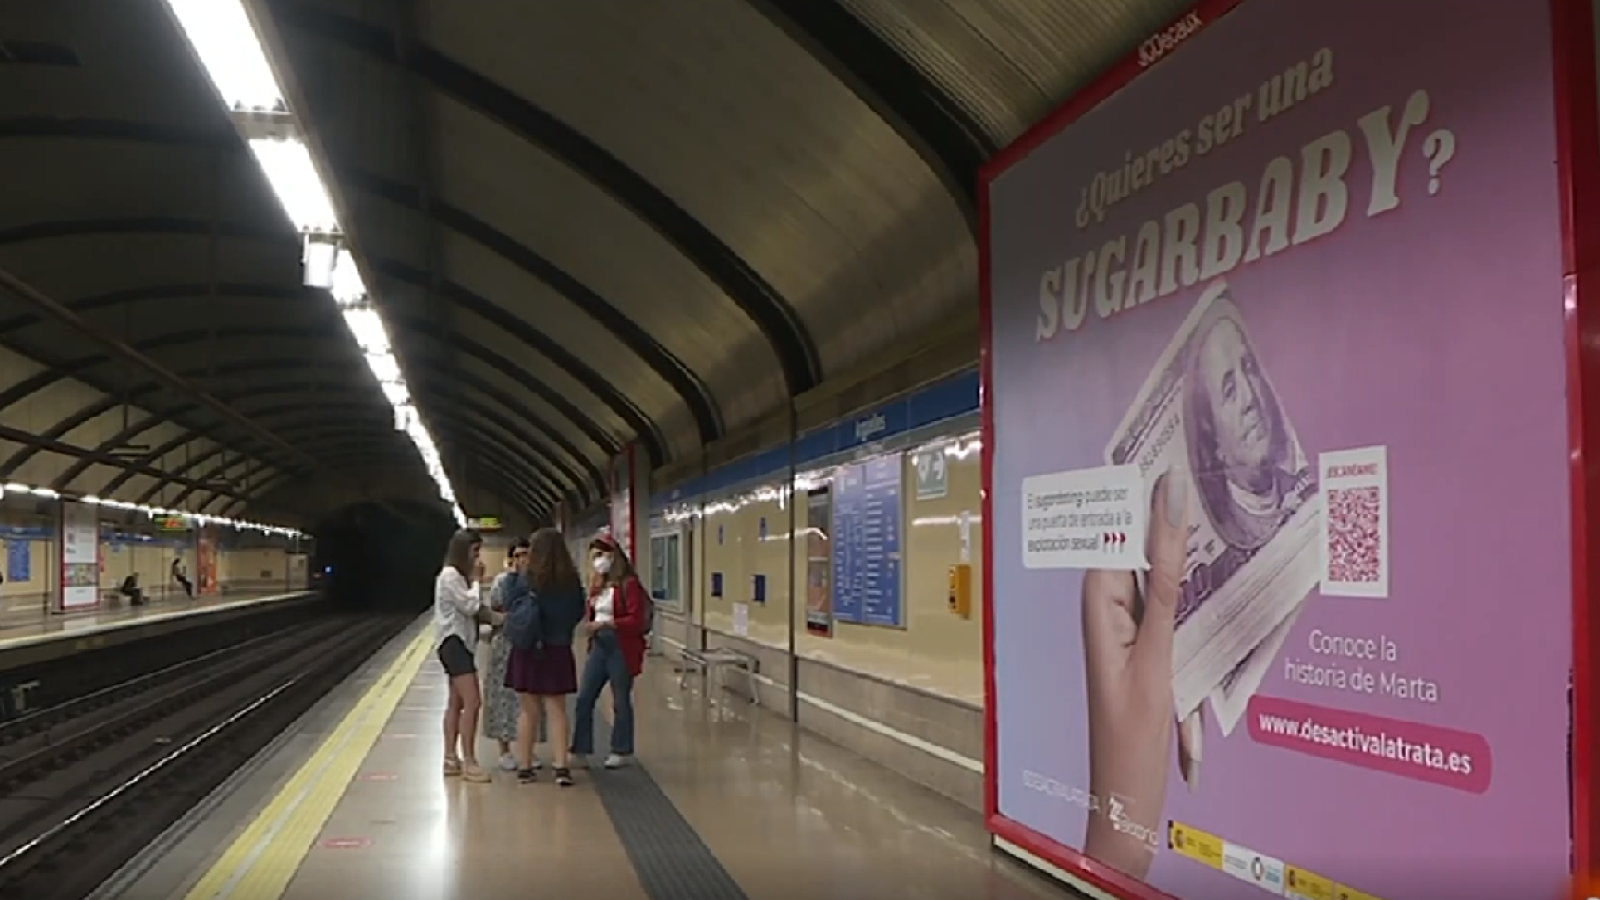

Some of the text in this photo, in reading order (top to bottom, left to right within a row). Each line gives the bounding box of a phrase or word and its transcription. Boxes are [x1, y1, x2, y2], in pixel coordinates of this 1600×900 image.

[1076, 47, 1334, 229] ¿Quieres ser una
[1035, 89, 1456, 342] SUGARBABY?
[1309, 629, 1397, 661] Conoce la
[1284, 657, 1438, 702] historia de Marta
[1259, 713, 1472, 775] www.desactivalatrata.es
